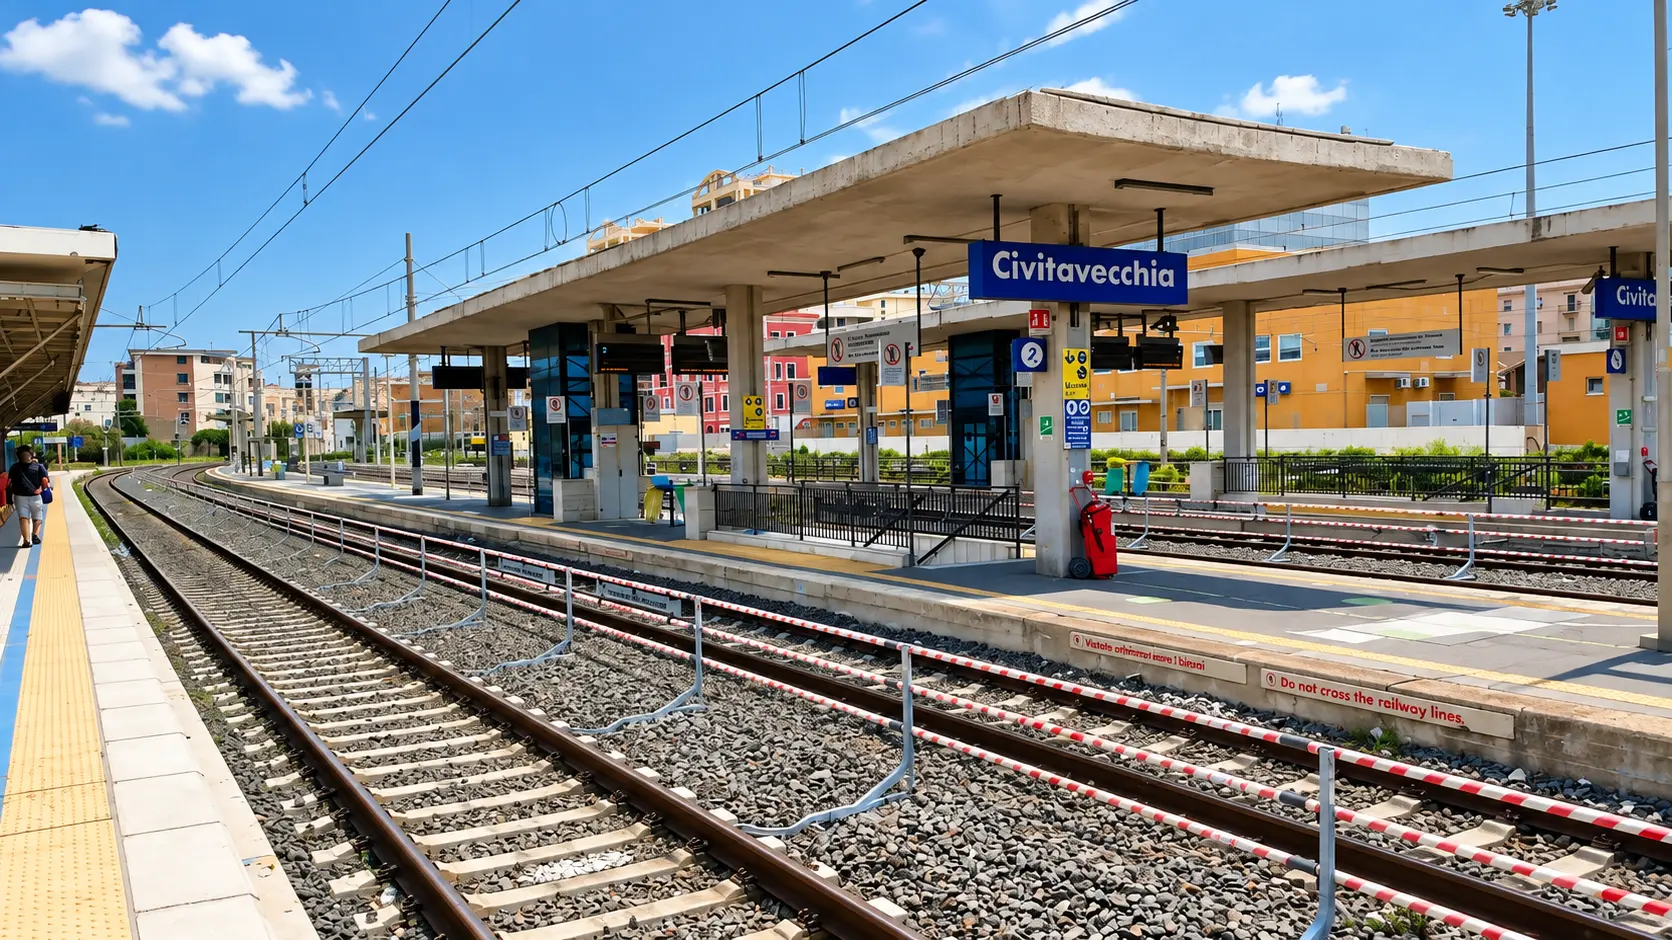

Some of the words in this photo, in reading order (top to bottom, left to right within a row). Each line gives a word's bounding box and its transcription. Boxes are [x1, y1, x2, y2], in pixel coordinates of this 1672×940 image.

[992, 250, 1175, 288] Civitavecchia
[1280, 676, 1295, 689] Do
[1298, 682, 1317, 694] not
[1320, 688, 1350, 701] cross
[1353, 690, 1374, 705] the
[1431, 704, 1465, 725] lines.
